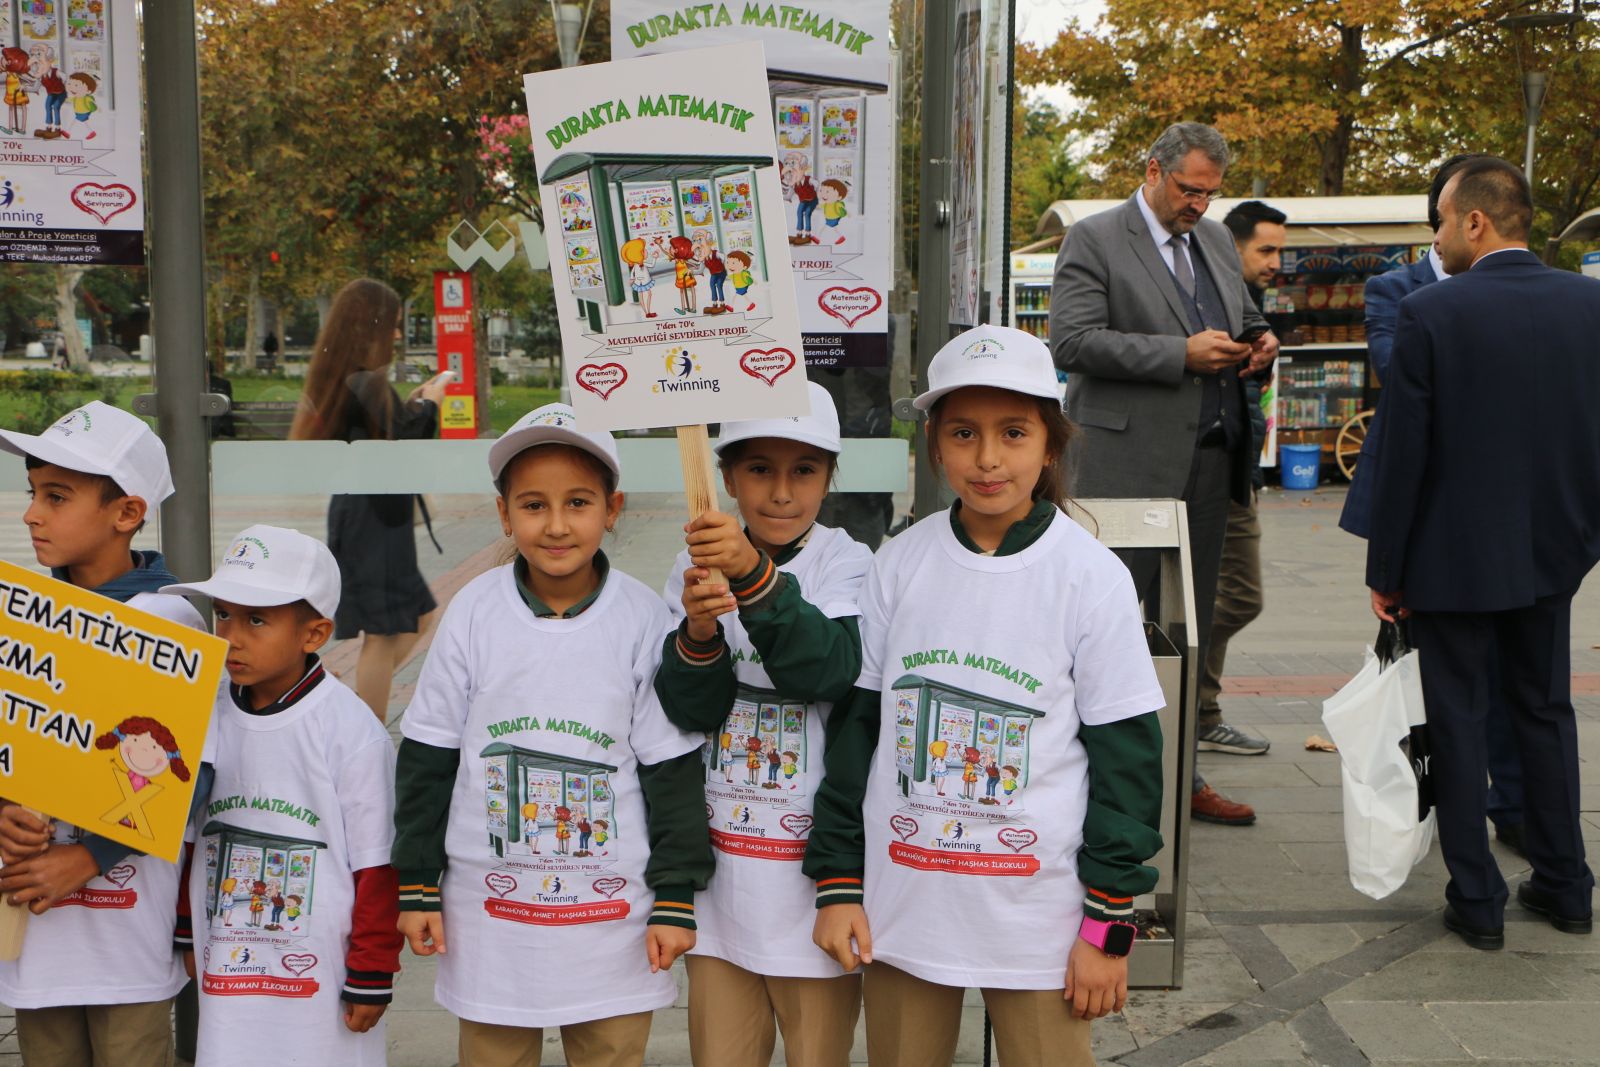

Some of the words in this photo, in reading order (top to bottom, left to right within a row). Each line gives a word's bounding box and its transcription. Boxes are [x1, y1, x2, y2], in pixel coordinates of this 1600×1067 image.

[627, 3, 733, 48] DURAKTA
[545, 99, 631, 150] DURAKTA
[50, 156, 85, 165] PROJE
[28, 232, 52, 241] Proje
[800, 260, 832, 270] PROJE
[830, 294, 870, 302] Matematiği
[656, 322, 677, 330] 7'den
[679, 321, 695, 329] 70'e
[607, 332, 667, 346] MATEMATİĞİ
[669, 328, 717, 341] SEVDİREN
[719, 326, 748, 338] PROJE
[750, 355, 785, 364] Matematiği
[753, 363, 785, 372] Seviyorum
[585, 370, 618, 378] Matematiği
[652, 378, 720, 394] eTwinning
[902, 650, 958, 670] DURAKTA
[487, 716, 540, 739] DURAKTA
[931, 838, 981, 852] eTwinning
[532, 894, 578, 903] eTwinning
